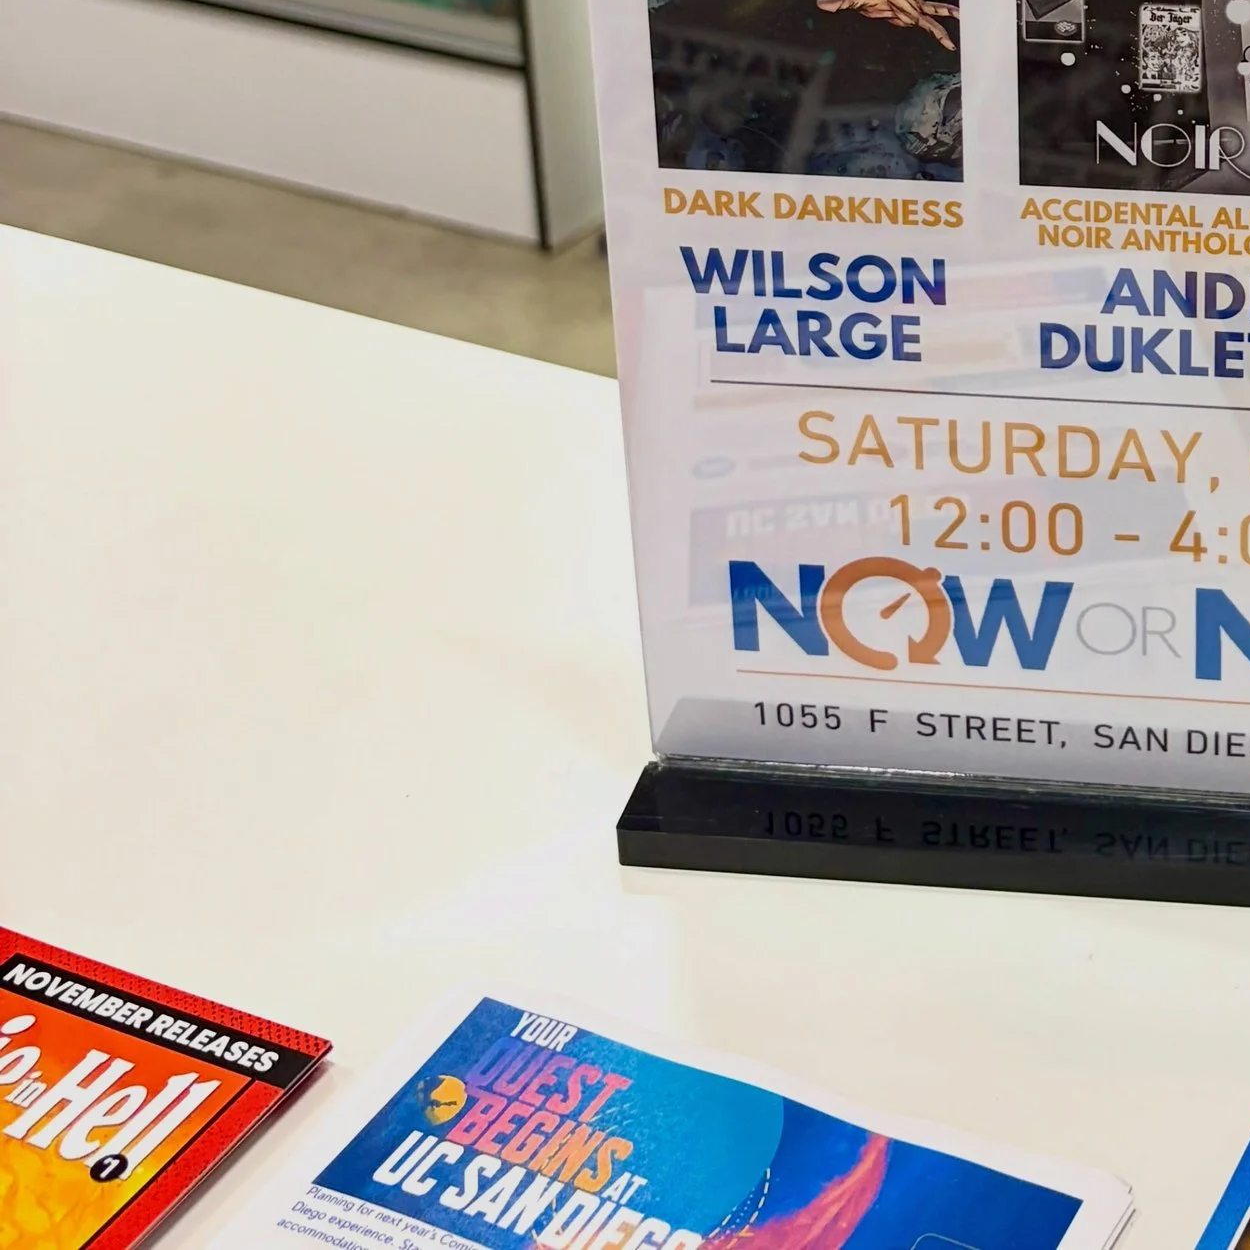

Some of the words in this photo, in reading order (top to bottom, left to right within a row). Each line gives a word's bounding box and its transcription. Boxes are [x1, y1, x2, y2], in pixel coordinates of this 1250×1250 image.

[664, 188, 764, 218] DARK
[773, 193, 964, 228] DARKNESS
[1020, 197, 1203, 228] ACCIDENTAL
[1038, 224, 1113, 249] NOIR
[680, 246, 946, 305] WILSON
[714, 306, 922, 362] LARGE
[798, 410, 1220, 493] SATURDAY,
[891, 495, 1084, 556] 12:00
[729, 556, 1074, 671] NOW
[1076, 603, 1181, 658] OR
[754, 701, 841, 731] 1055
[870, 709, 888, 732] F
[916, 713, 1067, 750] STREET,
[1094, 724, 1169, 754] SAN
[3, 963, 153, 1030] NOVEMBER
[146, 1014, 279, 1073] RELEASES
[509, 1011, 579, 1051] YOUR
[4, 1070, 48, 1109] in
[463, 1036, 633, 1123] QUEST
[3, 1048, 222, 1183] Hell
[446, 1090, 634, 1193] BEGINS
[602, 1172, 648, 1204] AT
[372, 1130, 464, 1196] UC
[439, 1154, 556, 1236] SAN
[291, 1201, 327, 1221] Diego
[328, 1215, 394, 1246] experience.
[306, 1186, 355, 1212] Planning
[357, 1202, 375, 1217] for
[375, 1212, 400, 1228] next
[404, 1221, 436, 1241] year's
